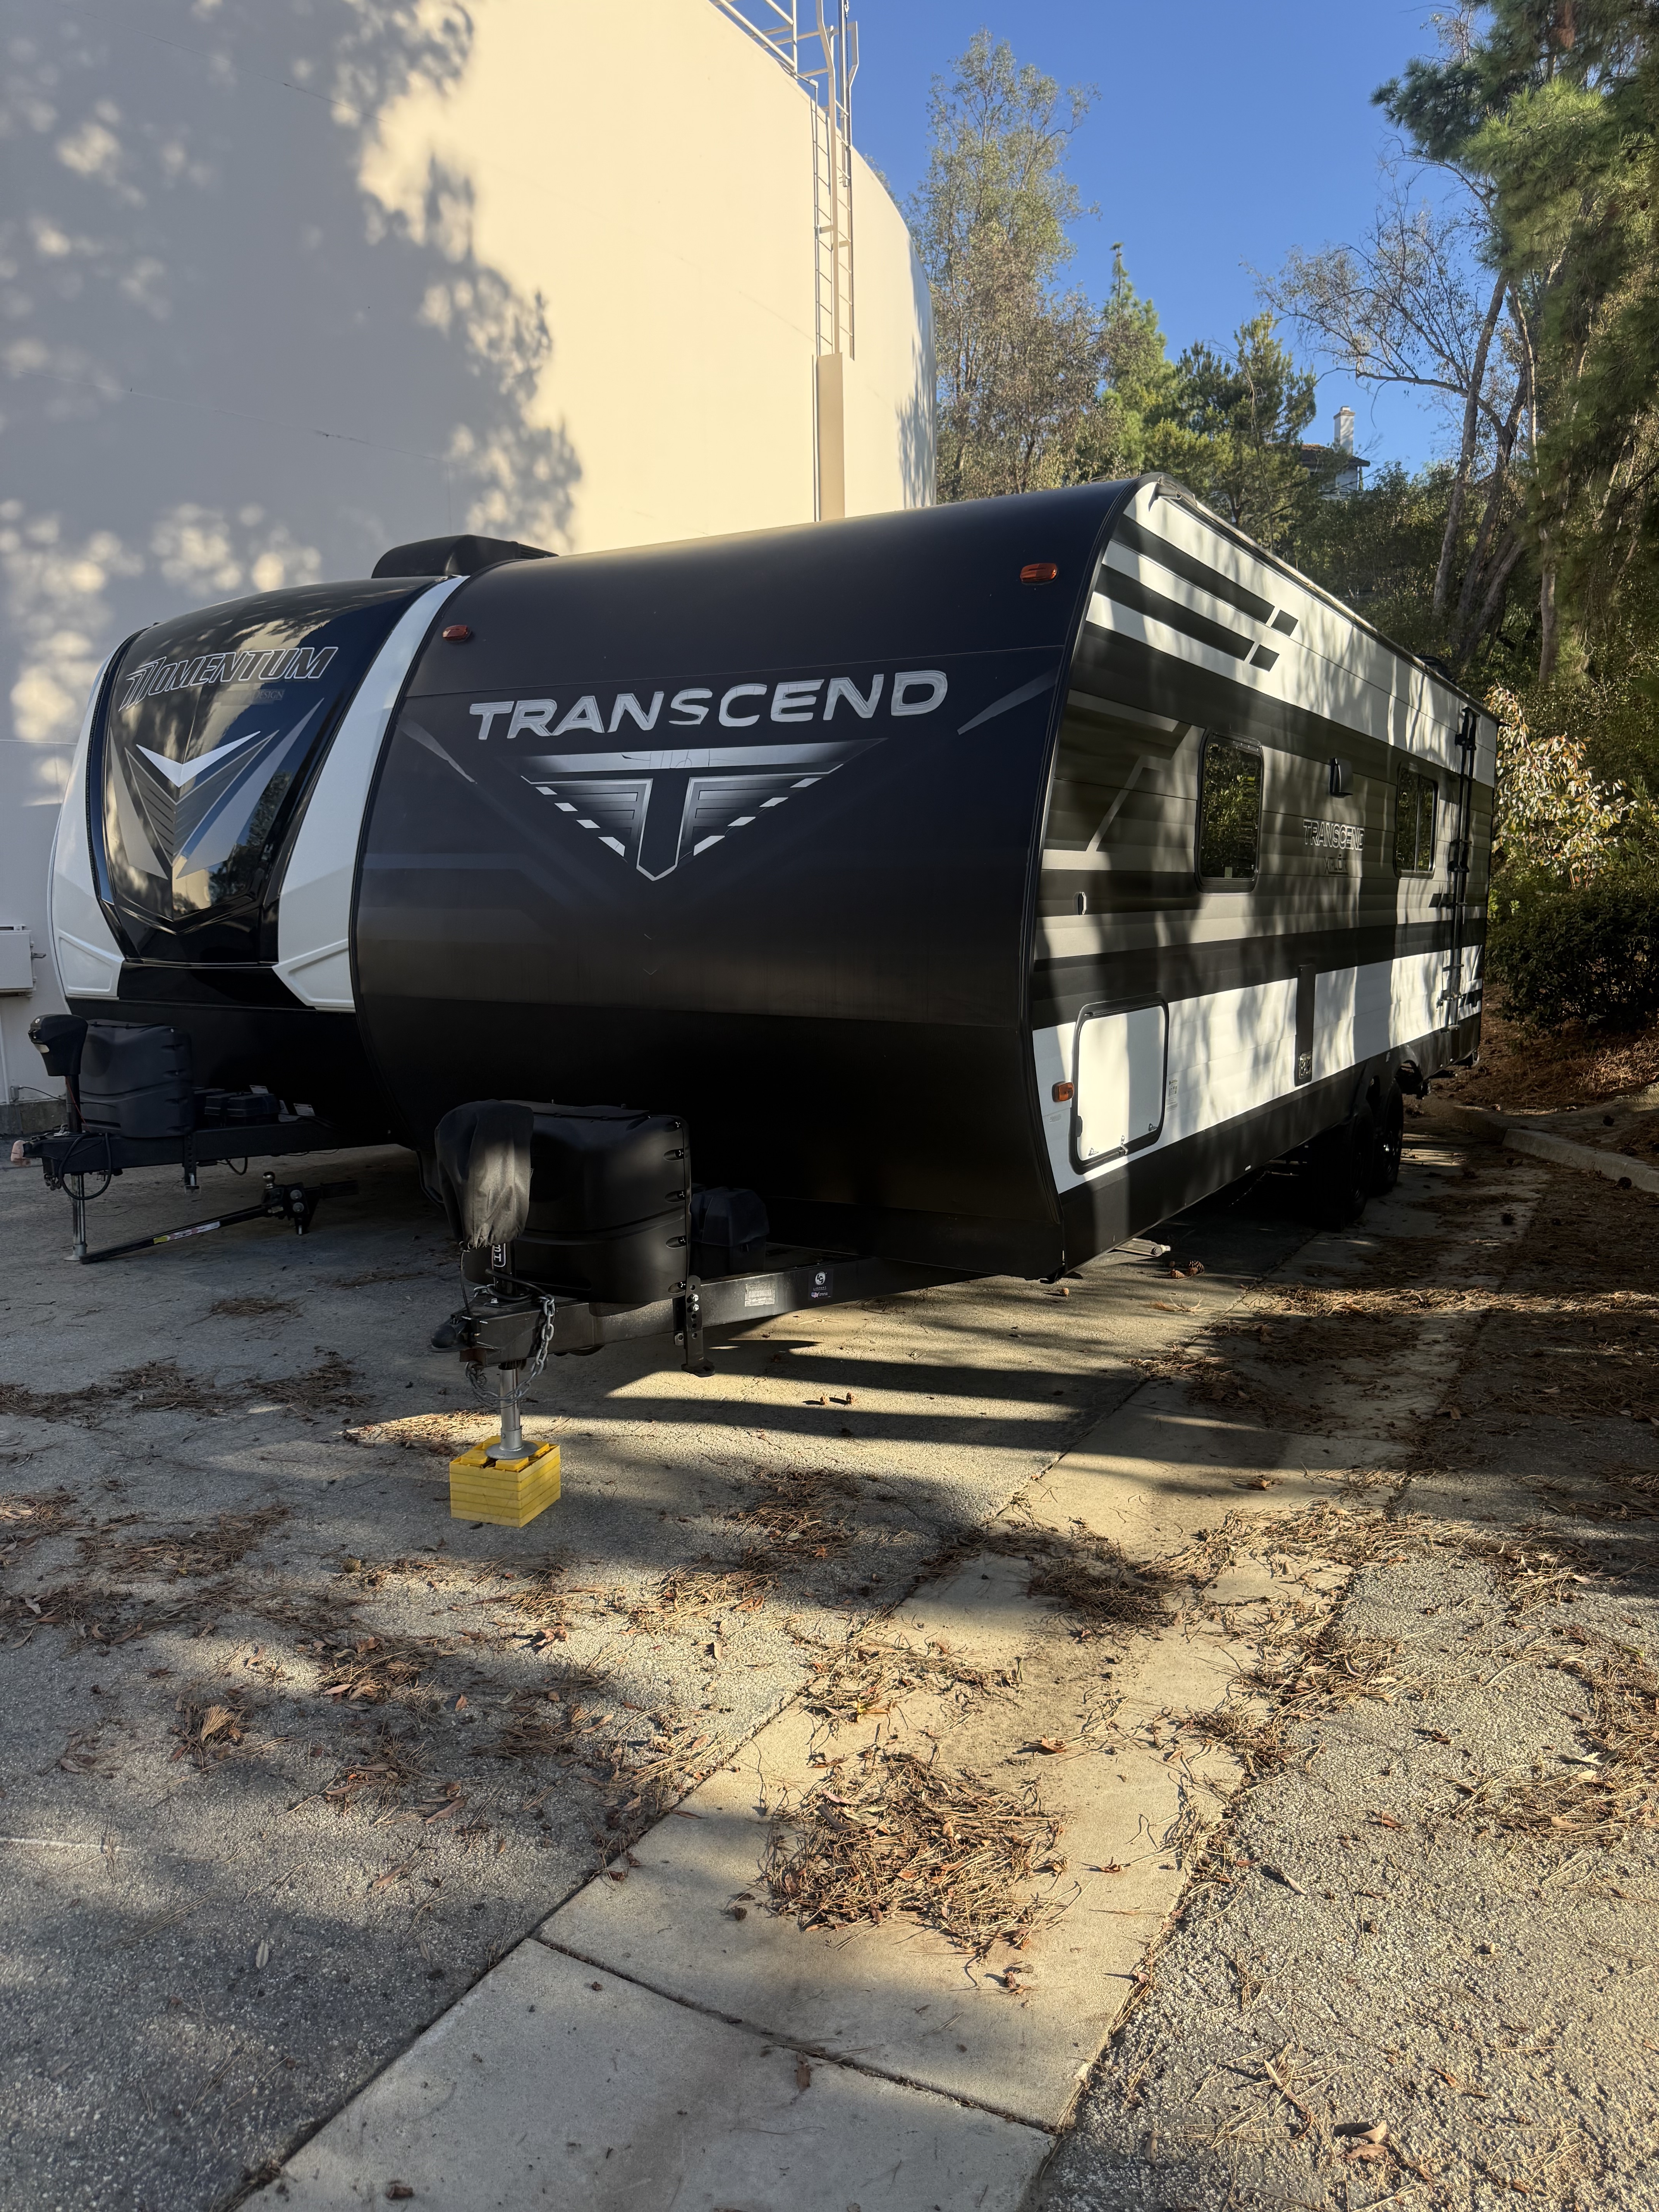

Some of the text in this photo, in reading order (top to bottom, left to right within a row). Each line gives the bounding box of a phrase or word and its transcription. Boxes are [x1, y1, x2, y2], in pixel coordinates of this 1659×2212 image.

[118, 647, 338, 712] MOMENTUM
[469, 670, 948, 740] TRANSCEND
[1303, 819, 1365, 851] TRANSCEND
